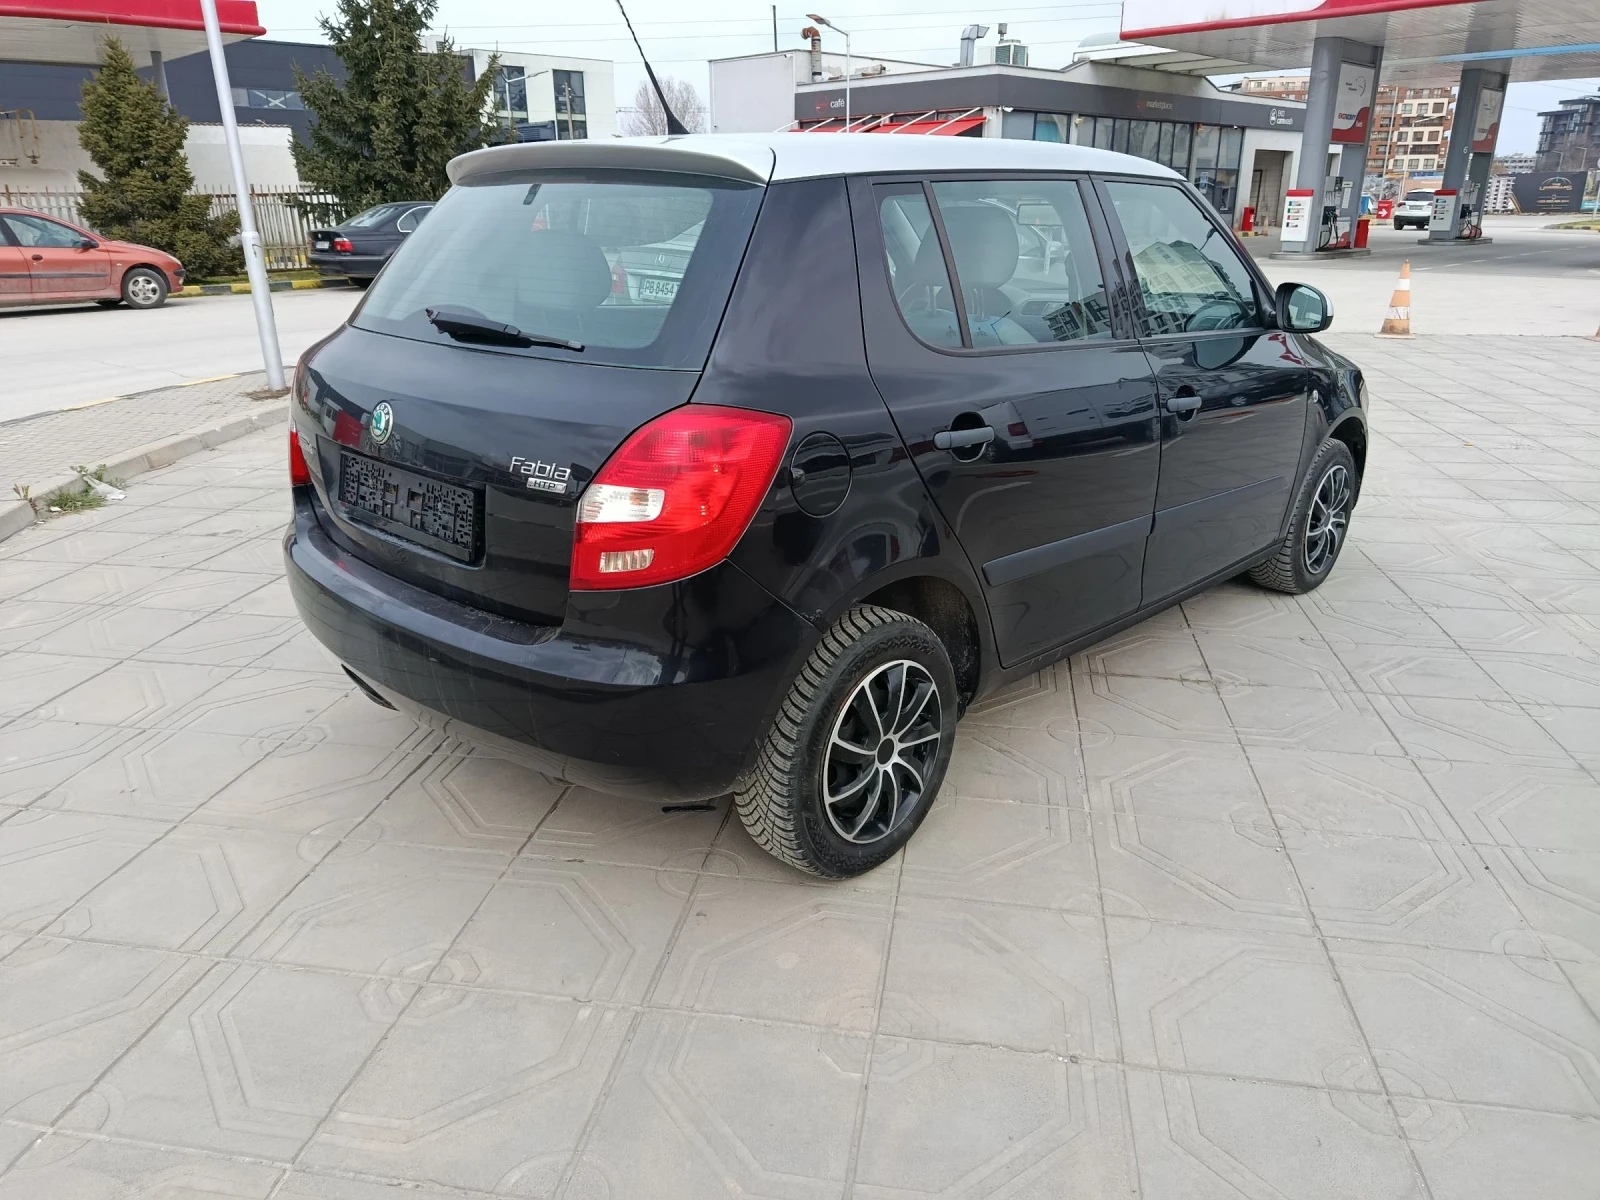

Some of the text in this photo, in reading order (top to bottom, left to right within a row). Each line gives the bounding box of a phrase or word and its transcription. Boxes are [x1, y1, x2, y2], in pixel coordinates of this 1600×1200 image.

[830, 98, 845, 108] café
[509, 456, 571, 480] Fabia
[533, 479, 556, 490] HTP
